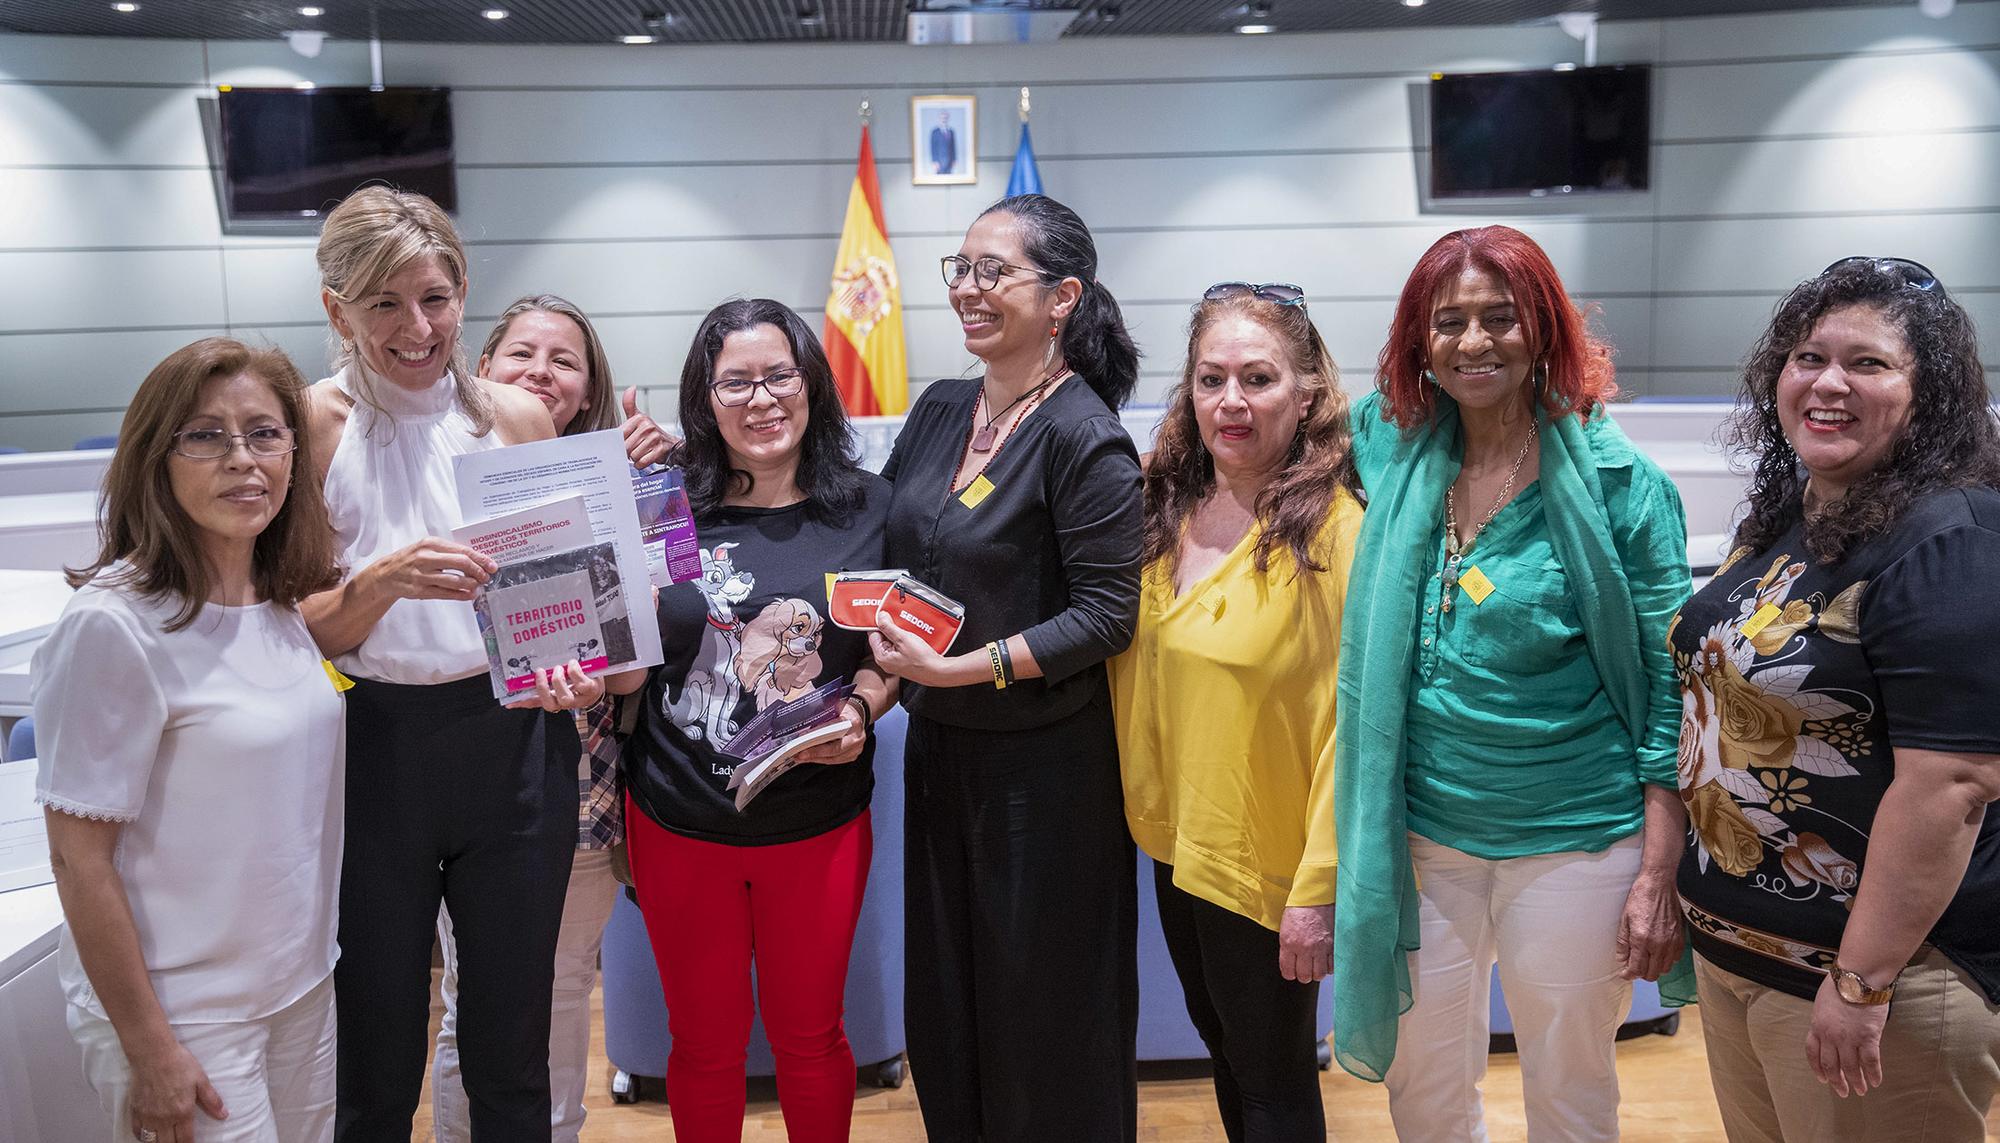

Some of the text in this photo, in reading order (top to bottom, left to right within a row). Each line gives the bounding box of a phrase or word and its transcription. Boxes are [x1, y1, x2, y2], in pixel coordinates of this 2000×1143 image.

[471, 520, 543, 545] BIOSINDICALISMO
[472, 519, 571, 552] DESDE LOS TERRITORIOS
[481, 538, 529, 555] OMÉSTICOS
[506, 599, 583, 626] TERRITORIO
[899, 610, 935, 635] SEDOAC
[513, 613, 586, 645] DOMÉSTICO
[989, 647, 1004, 682] SEDOAC
